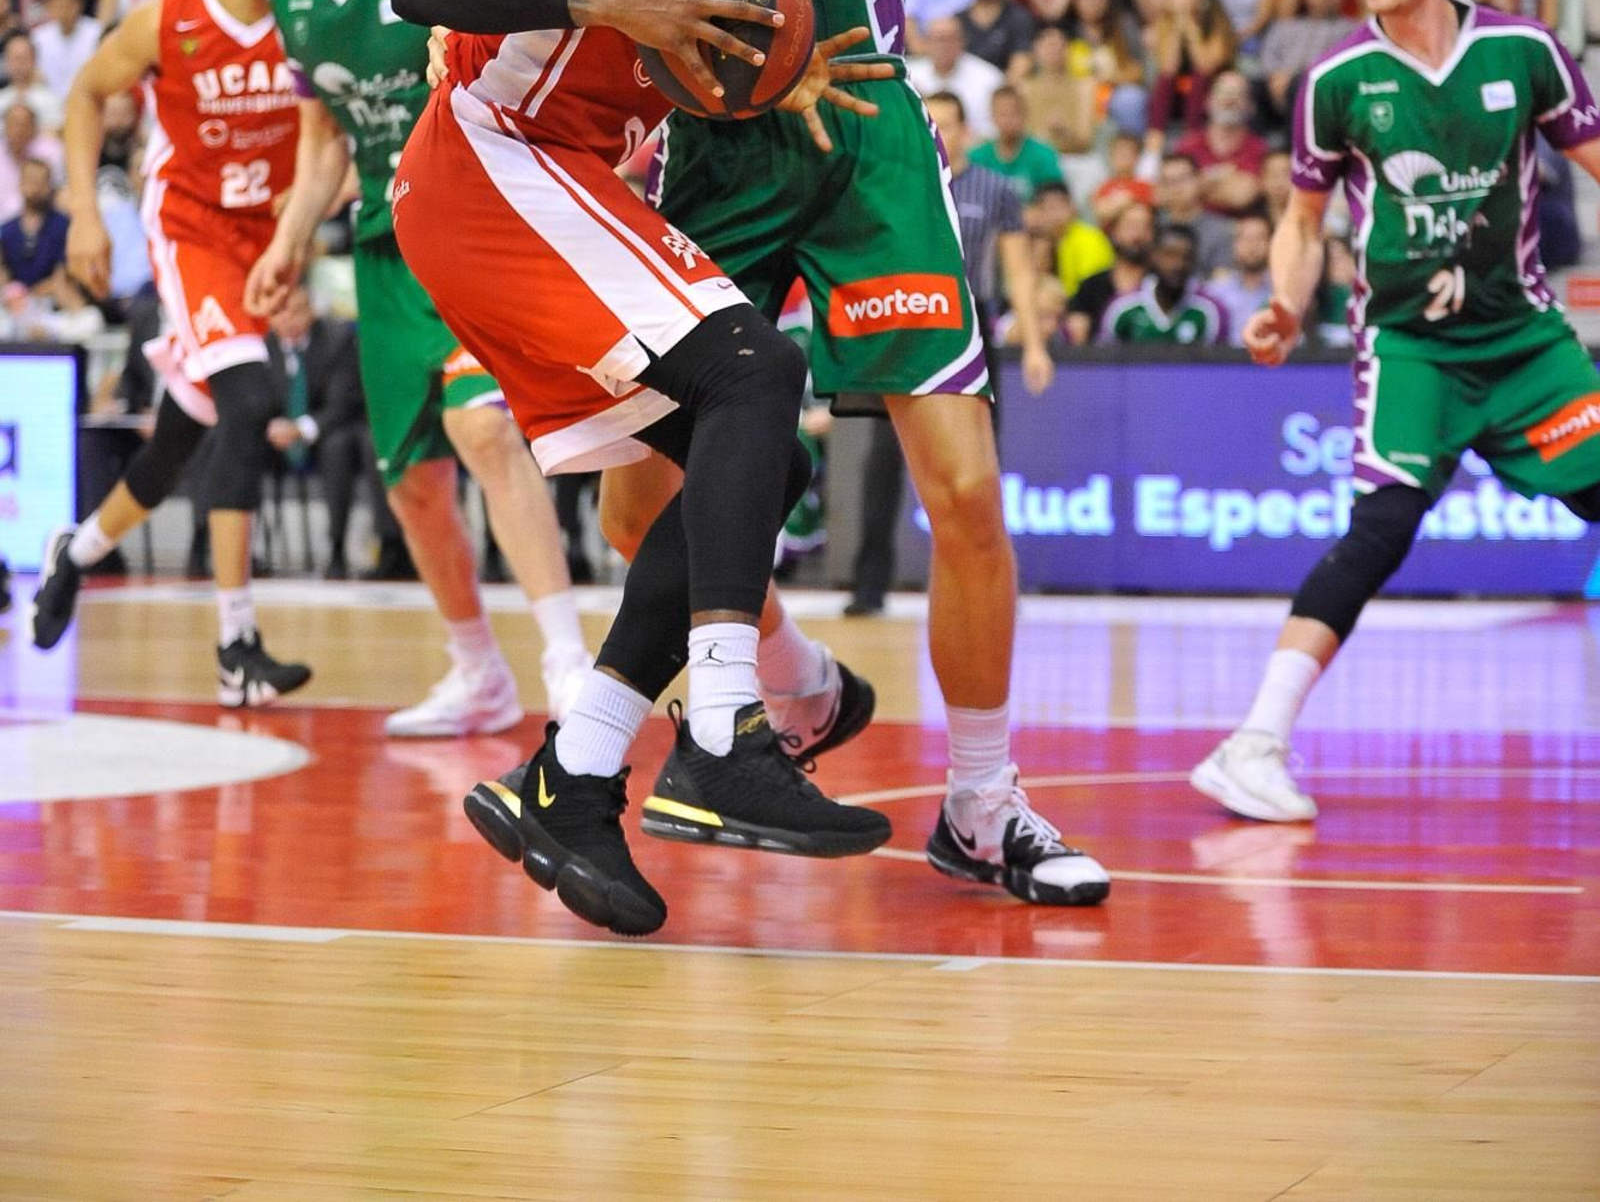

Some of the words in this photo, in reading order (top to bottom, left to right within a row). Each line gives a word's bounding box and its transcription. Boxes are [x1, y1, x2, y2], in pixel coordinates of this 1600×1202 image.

[220, 159, 272, 209] 22
[844, 288, 949, 323] worten
[1424, 265, 1466, 322] 21
